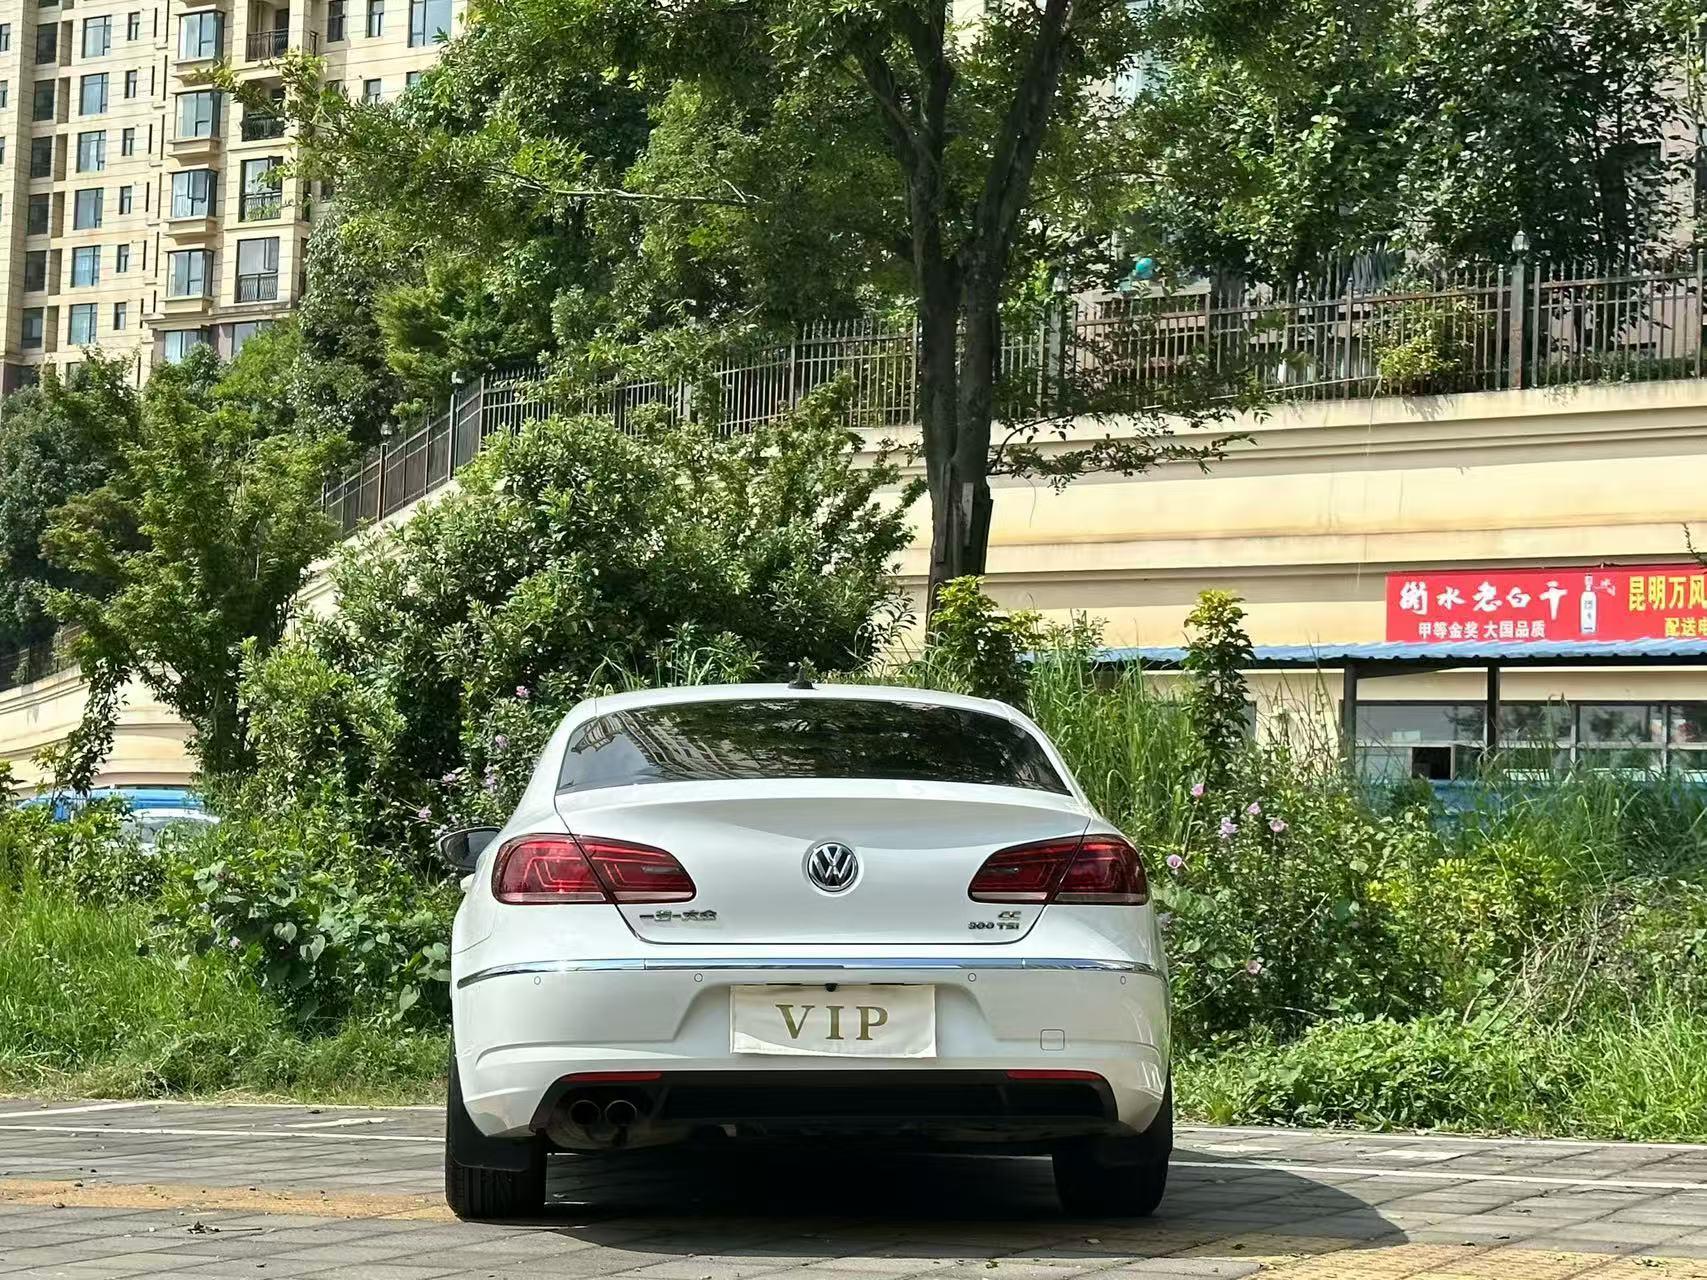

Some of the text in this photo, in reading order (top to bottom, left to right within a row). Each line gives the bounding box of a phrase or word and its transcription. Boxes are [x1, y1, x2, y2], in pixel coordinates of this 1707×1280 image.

[1629, 575, 1707, 611] 昆明万风
[1418, 620, 1546, 639] 甲等金奖 大国品质
[997, 922, 1020, 931] TSI
[775, 1004, 889, 1041] VIP
